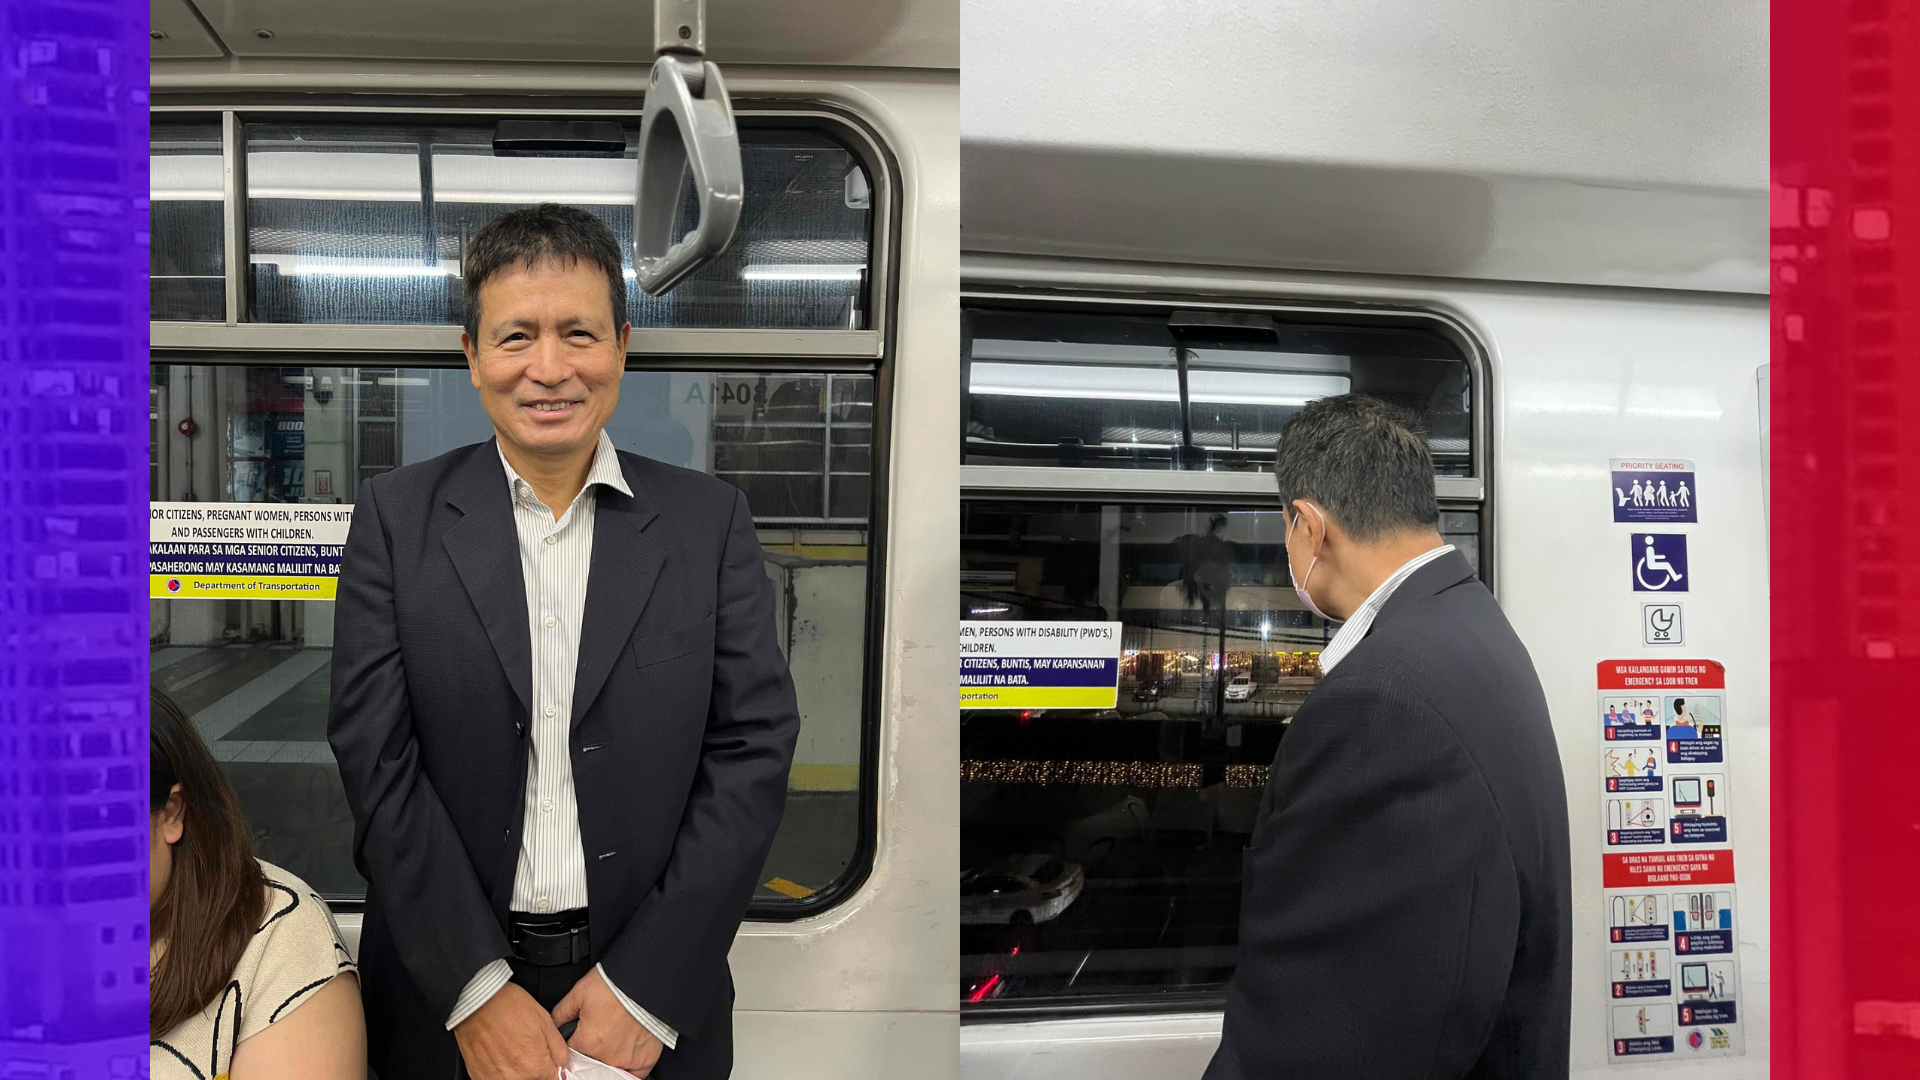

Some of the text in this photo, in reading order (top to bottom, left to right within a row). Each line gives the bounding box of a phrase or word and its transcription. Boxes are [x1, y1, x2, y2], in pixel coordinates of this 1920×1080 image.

[1620, 462, 1685, 471] PRIORITY SEATING
[166, 509, 205, 522] CITIZENS,
[207, 509, 252, 521] PREGNANT
[254, 510, 292, 523] WOMEN,
[293, 511, 332, 522] PERSONS
[171, 526, 314, 540] AND PASSENGERS WITH CHILDREN.
[188, 544, 211, 556] PARA
[212, 544, 224, 556] SA
[225, 544, 246, 556] MGA
[247, 545, 279, 557] SENIOR
[280, 545, 319, 559] CITIZENS,
[205, 561, 225, 573] MAY
[226, 562, 275, 574] KASAMANG
[276, 563, 313, 575] MALILIIT
[314, 563, 327, 575] NA
[328, 563, 341, 575] BA
[193, 580, 320, 592] Department of Transportation
[979, 626, 1015, 638] PERSONS
[1016, 627, 1037, 638] WITH
[1038, 627, 1079, 639] DISABILITY
[964, 658, 1000, 671] CITIZENS,
[1001, 658, 1032, 671] BUNTIS,
[1033, 659, 1052, 670] MAY
[1052, 659, 1106, 670] KAPANSANAN
[1616, 665, 1628, 674] MGA
[1677, 666, 1685, 674] SA
[1685, 665, 1699, 674] ORAS
[1699, 665, 1707, 674] NG
[960, 674, 1030, 686] MALILIIT NA BATA.
[1625, 676, 1699, 686] EMERGENCY SA LOOB NG TREN
[1622, 856, 1628, 864] SA
[1666, 855, 1676, 863] ANG
[1688, 854, 1694, 862] SA
[1664, 864, 1690, 872] EMERGENCY
